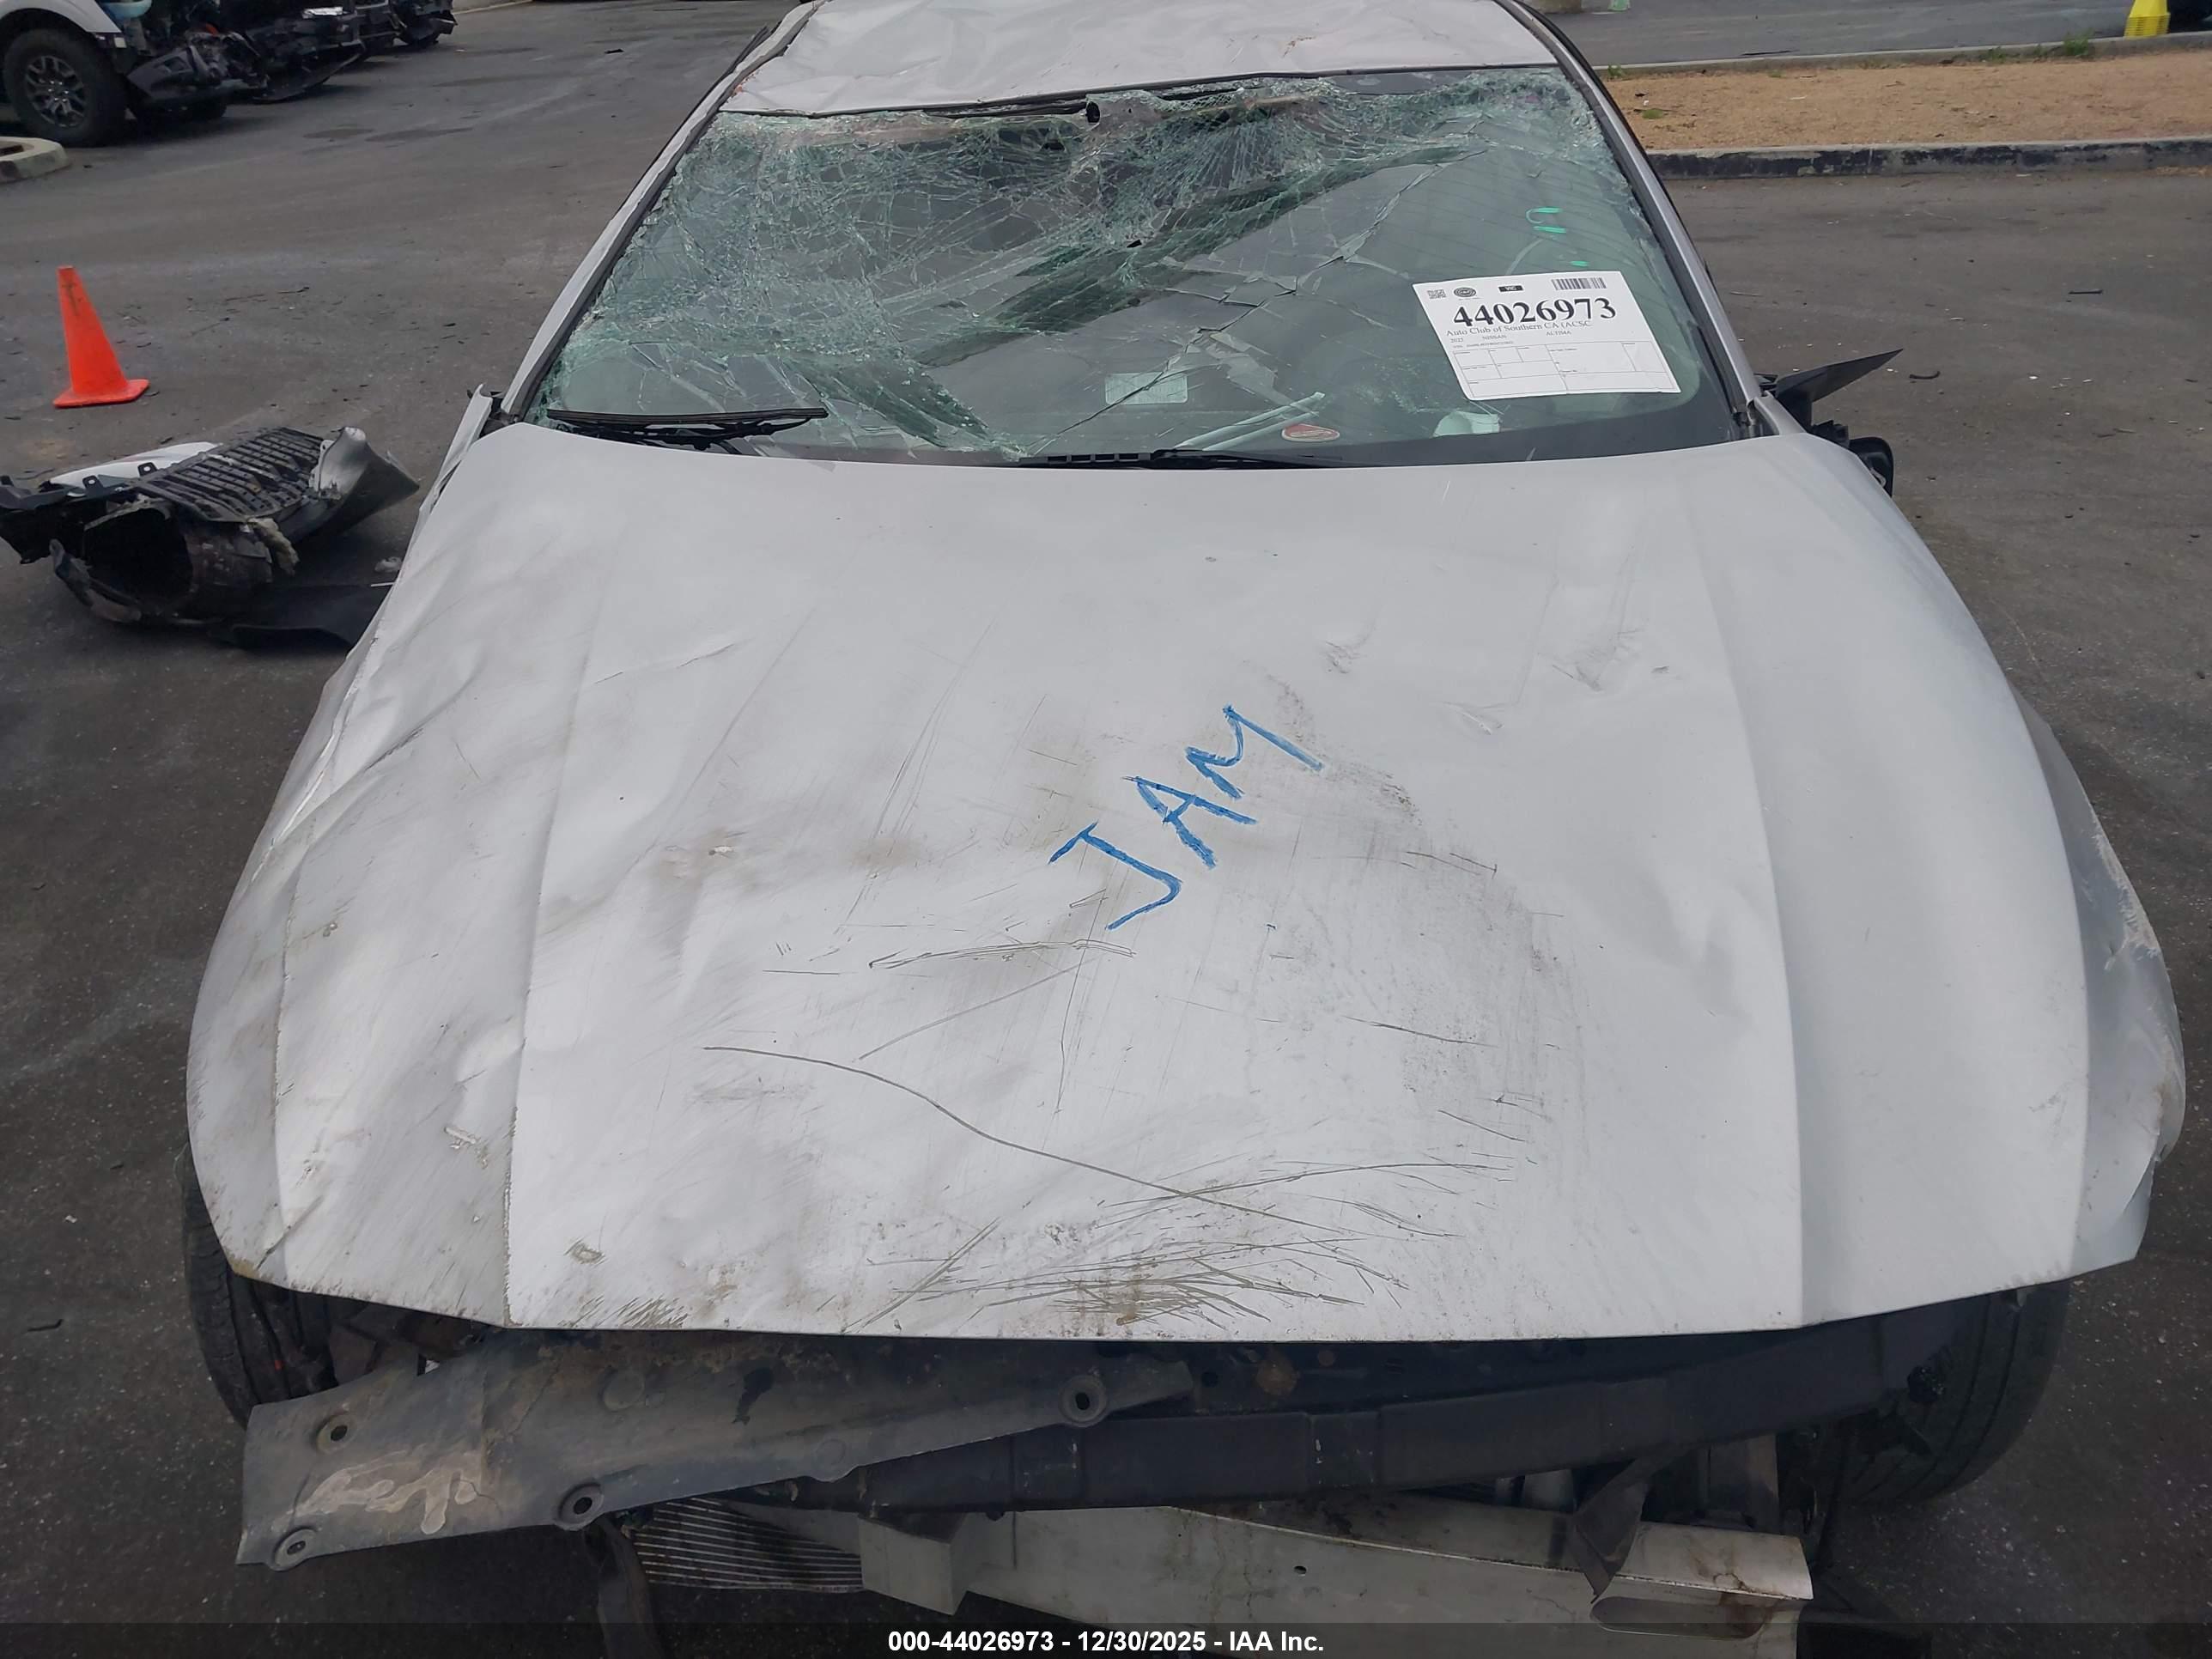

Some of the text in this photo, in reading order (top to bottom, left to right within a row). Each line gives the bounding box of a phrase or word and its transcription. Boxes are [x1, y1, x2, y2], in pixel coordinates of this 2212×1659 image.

[1454, 298, 1616, 327] 44026973
[1504, 324, 1542, 332] Southern
[1048, 705, 1324, 930] JAM
